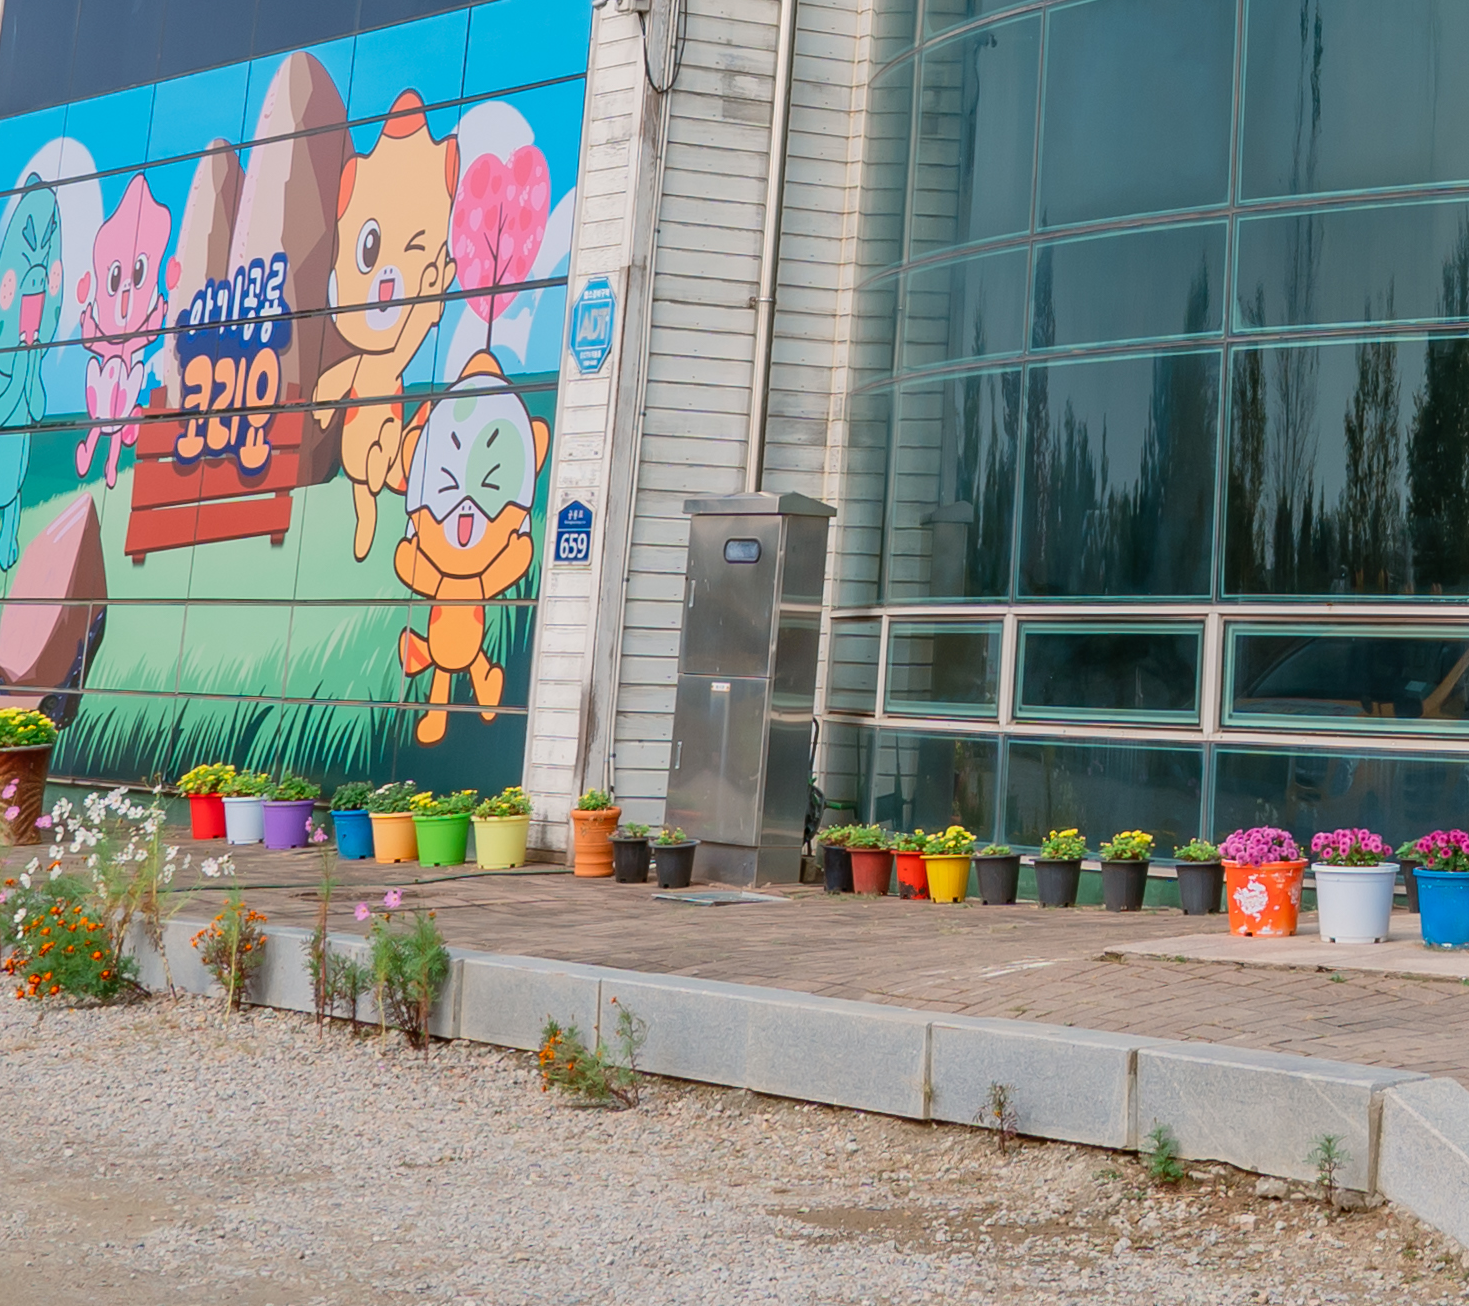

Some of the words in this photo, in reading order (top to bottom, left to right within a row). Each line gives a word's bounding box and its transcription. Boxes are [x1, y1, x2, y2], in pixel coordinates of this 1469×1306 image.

[188, 261, 287, 343] 아기공룡
[578, 307, 610, 342] ADT
[177, 347, 280, 469] 코리요
[559, 533, 588, 559] 659
